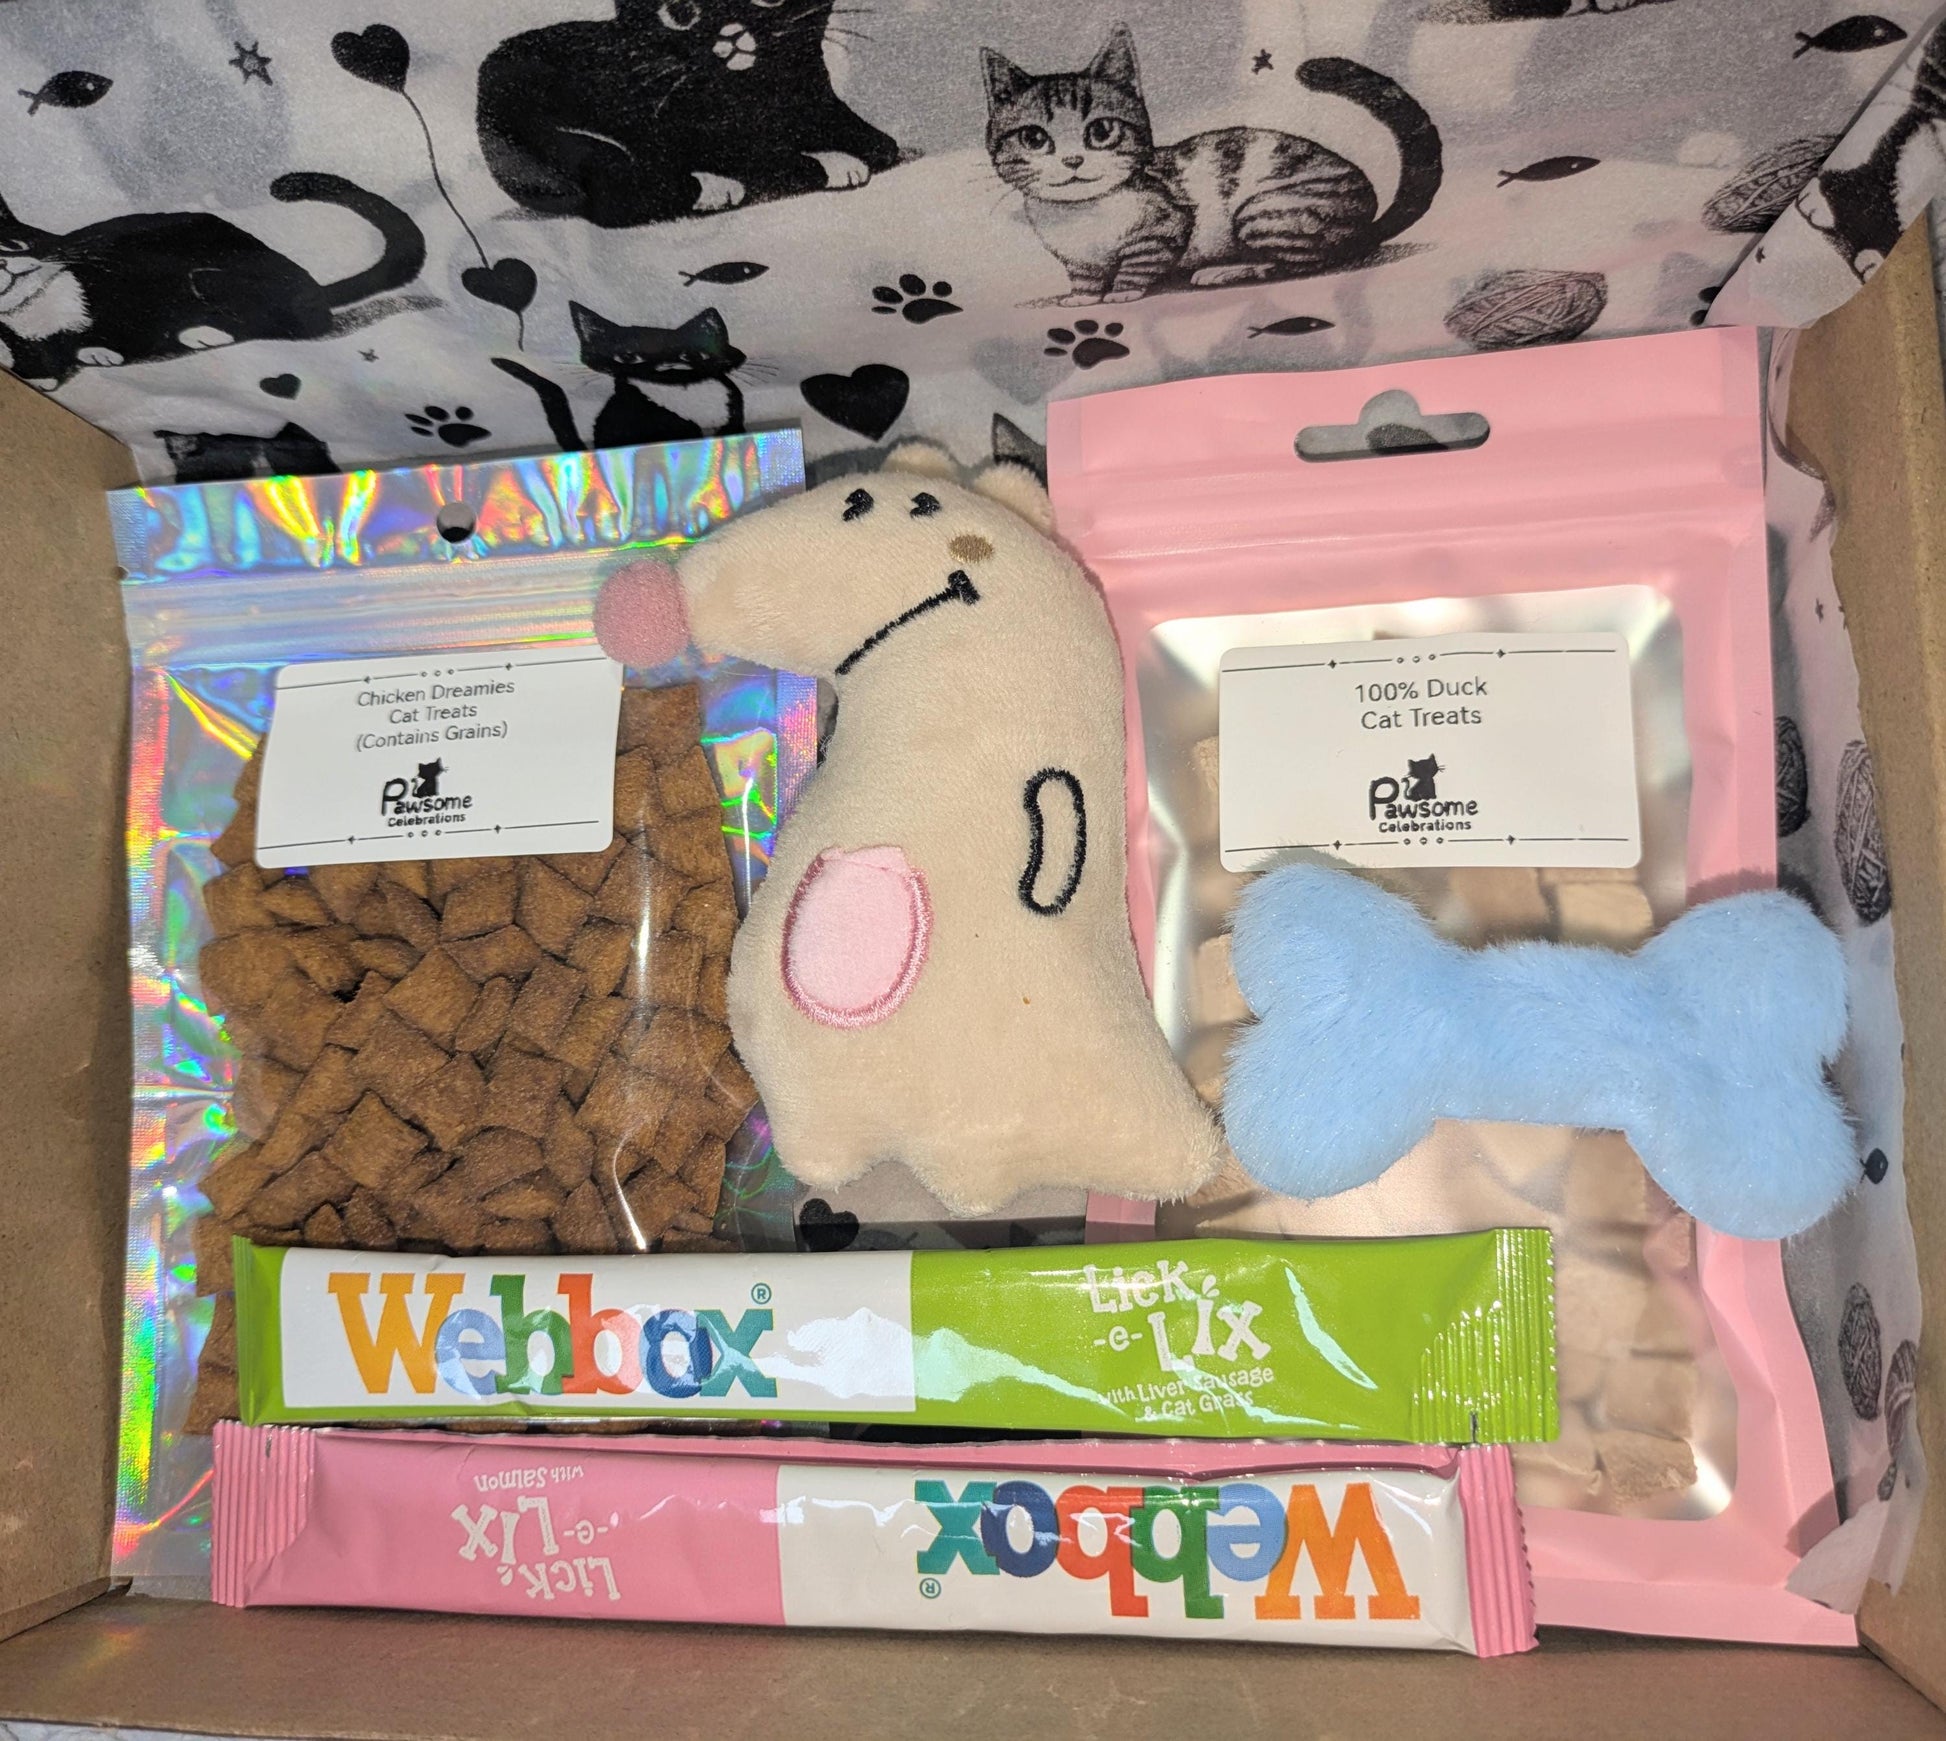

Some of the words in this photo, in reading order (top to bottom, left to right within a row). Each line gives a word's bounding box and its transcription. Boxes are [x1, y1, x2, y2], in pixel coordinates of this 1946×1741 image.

[356, 686, 426, 708] Chicken
[432, 679, 516, 701] Dreamies
[1354, 681, 1419, 704] 100%
[1426, 676, 1488, 698] Duck
[389, 707, 420, 725] Cat
[425, 703, 478, 722] Treats
[1361, 709, 1403, 730] Cat
[1409, 706, 1482, 728] Treats
[356, 728, 440, 753] (Contains
[445, 720, 509, 743] Grains)
[381, 777, 473, 816] Pawsome
[1368, 776, 1479, 820] Pawsome
[387, 811, 467, 827] Celebrations
[1378, 818, 1472, 833] Celebrations
[1137, 1381, 1185, 1403] Liver
[1161, 1400, 1196, 1417] Cat
[473, 1467, 547, 1492] Salmon
